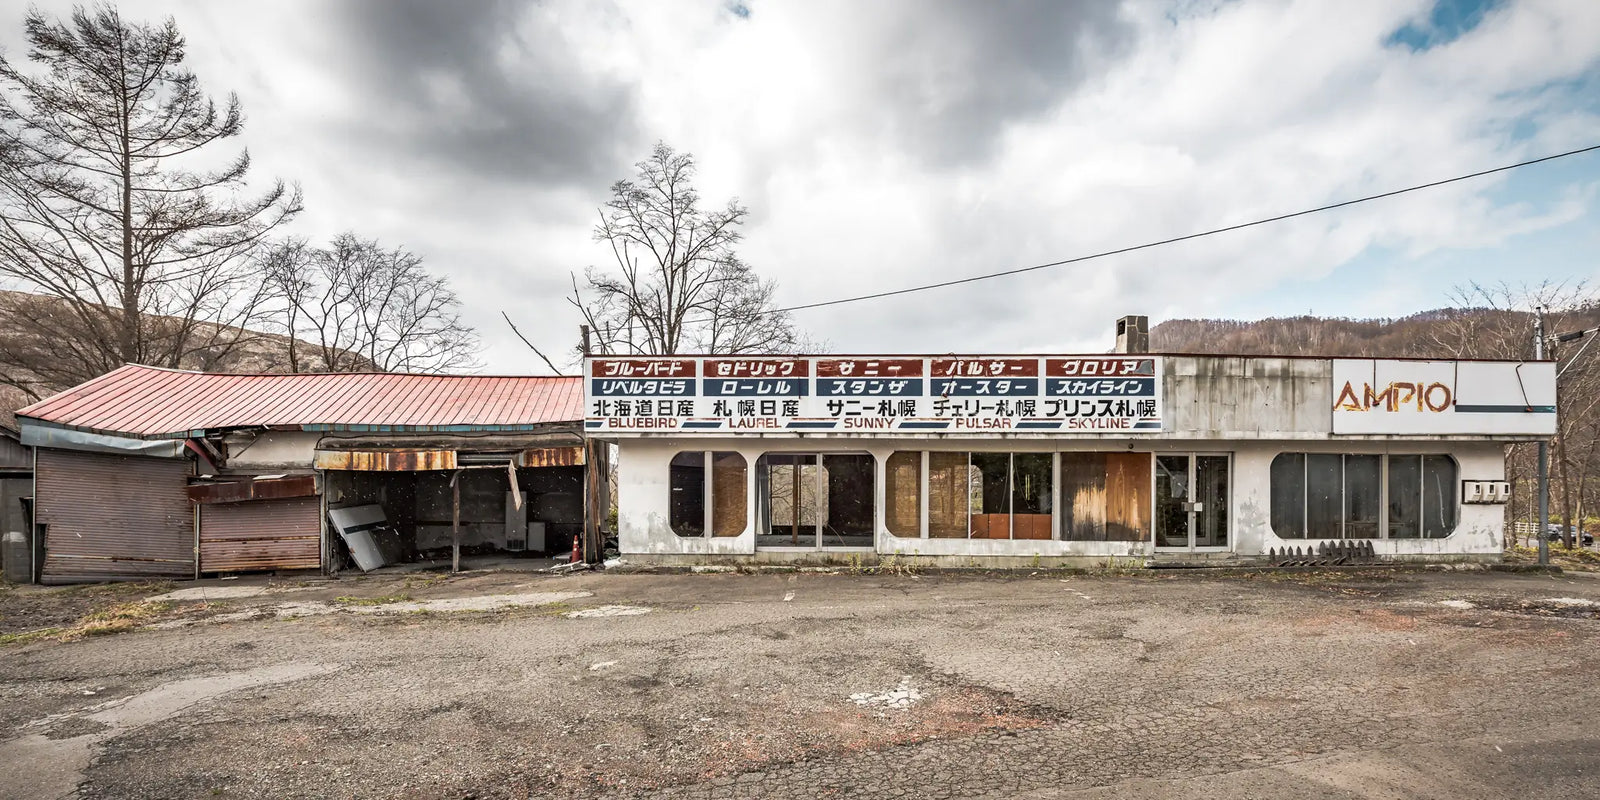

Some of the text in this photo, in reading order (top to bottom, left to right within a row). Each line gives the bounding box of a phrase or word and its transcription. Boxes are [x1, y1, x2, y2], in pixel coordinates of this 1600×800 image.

[717, 361, 794, 376] セドリック
[839, 362, 902, 376] サニー
[946, 361, 1023, 375] パルサー
[1062, 360, 1138, 374] グロリア
[602, 381, 686, 394] リベルタビラ
[721, 381, 791, 394] ローレル
[831, 380, 908, 394] スタンザ
[941, 380, 1027, 394] オースター
[1056, 380, 1142, 394] スカイライン
[1334, 380, 1452, 412] AMPIO
[592, 400, 694, 416] 北海道日産
[713, 400, 799, 416] 札幌日産
[826, 400, 916, 416] サニー札幌
[933, 399, 1036, 416] チェリー札幌
[1044, 398, 1156, 416] プリンス札幌
[608, 418, 678, 428] BLUEBIRD
[729, 418, 782, 428] LAUREL
[844, 418, 895, 428] SUNNY
[956, 418, 1012, 428] PULSAR
[1068, 418, 1130, 428] SKYLINE
